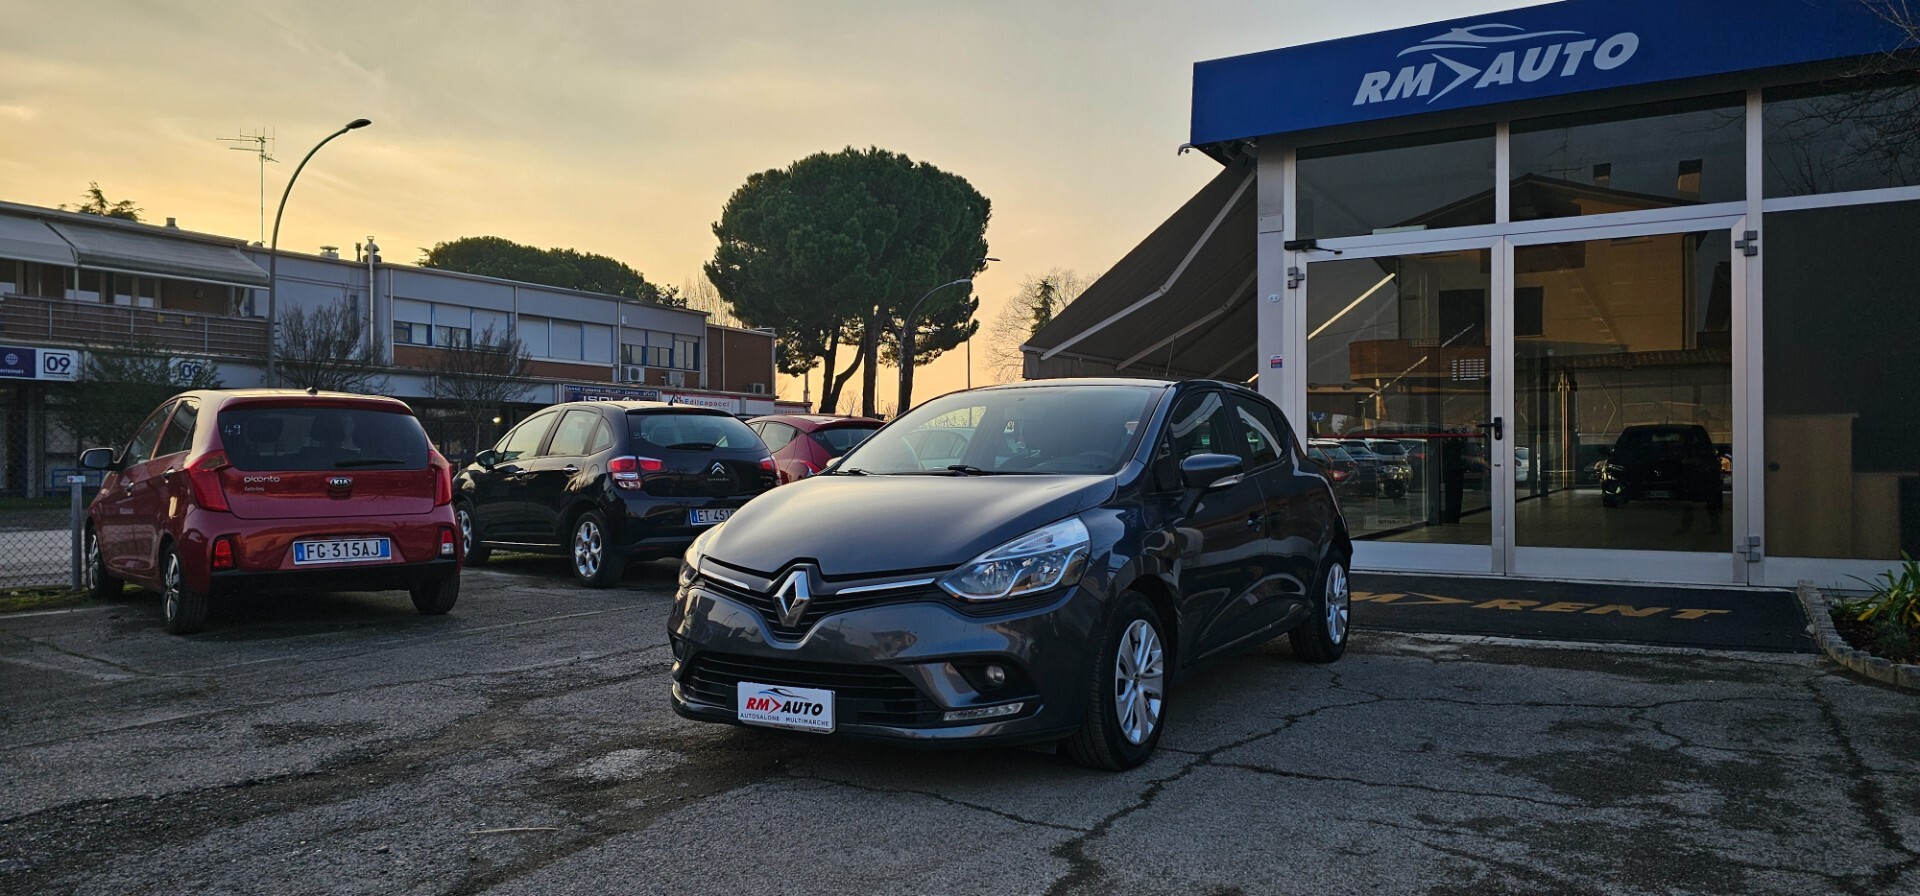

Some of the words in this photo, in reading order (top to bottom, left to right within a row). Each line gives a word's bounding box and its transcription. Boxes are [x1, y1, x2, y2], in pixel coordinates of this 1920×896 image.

[1473, 32, 1639, 89] AUTO
[46, 356, 70, 371] 09
[780, 700, 824, 716] AUTO
[740, 712, 780, 721] AUTOSALONE
[785, 716, 829, 727] MULTIMARCHE
